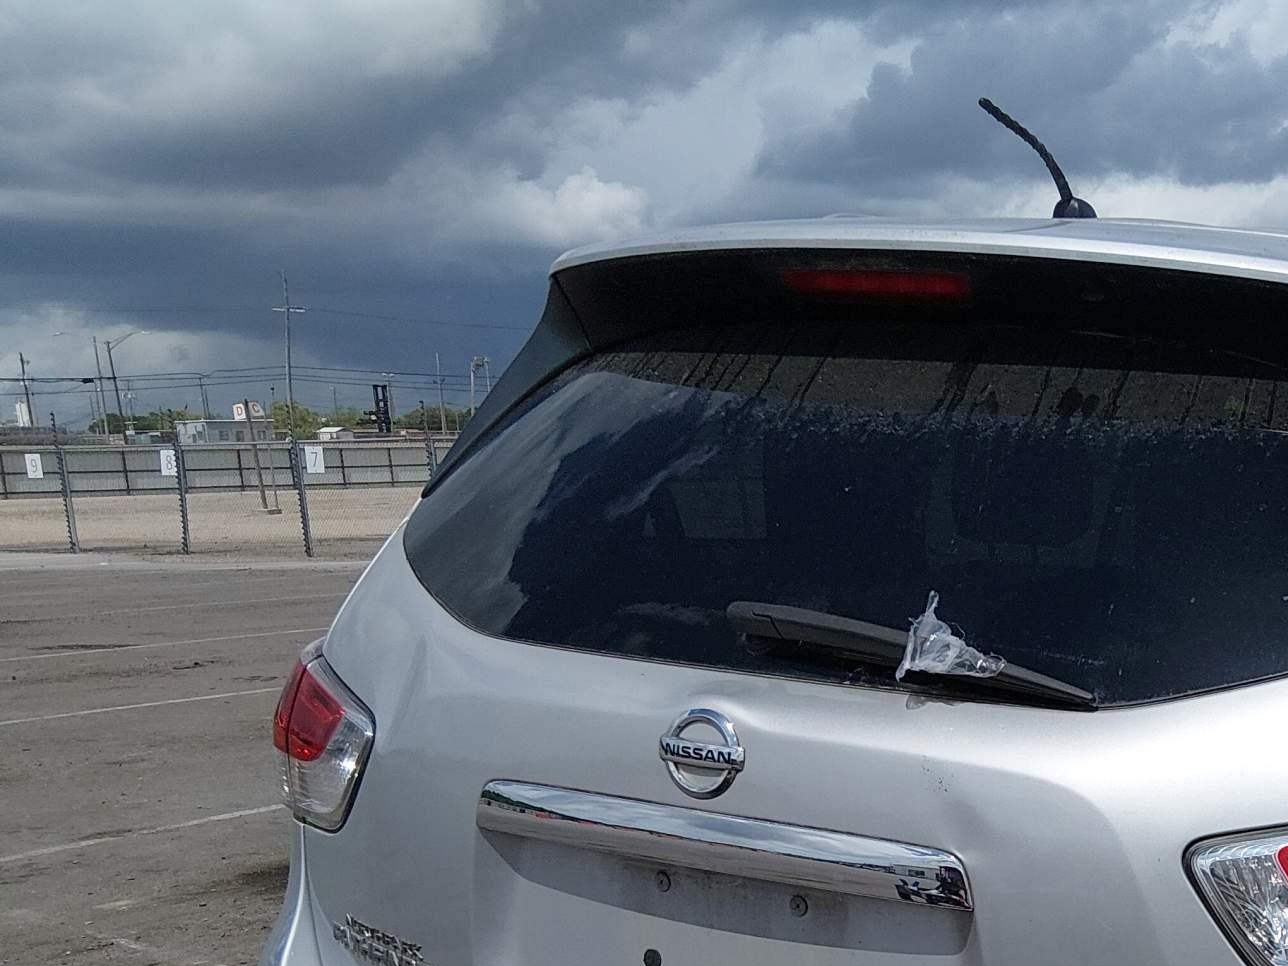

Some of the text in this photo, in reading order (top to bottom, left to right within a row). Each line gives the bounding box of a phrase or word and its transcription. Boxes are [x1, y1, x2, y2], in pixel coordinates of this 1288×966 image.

[30, 458, 38, 473] 9
[166, 455, 173, 470] 8
[310, 451, 318, 467] 7
[665, 742, 732, 764] NISSAN
